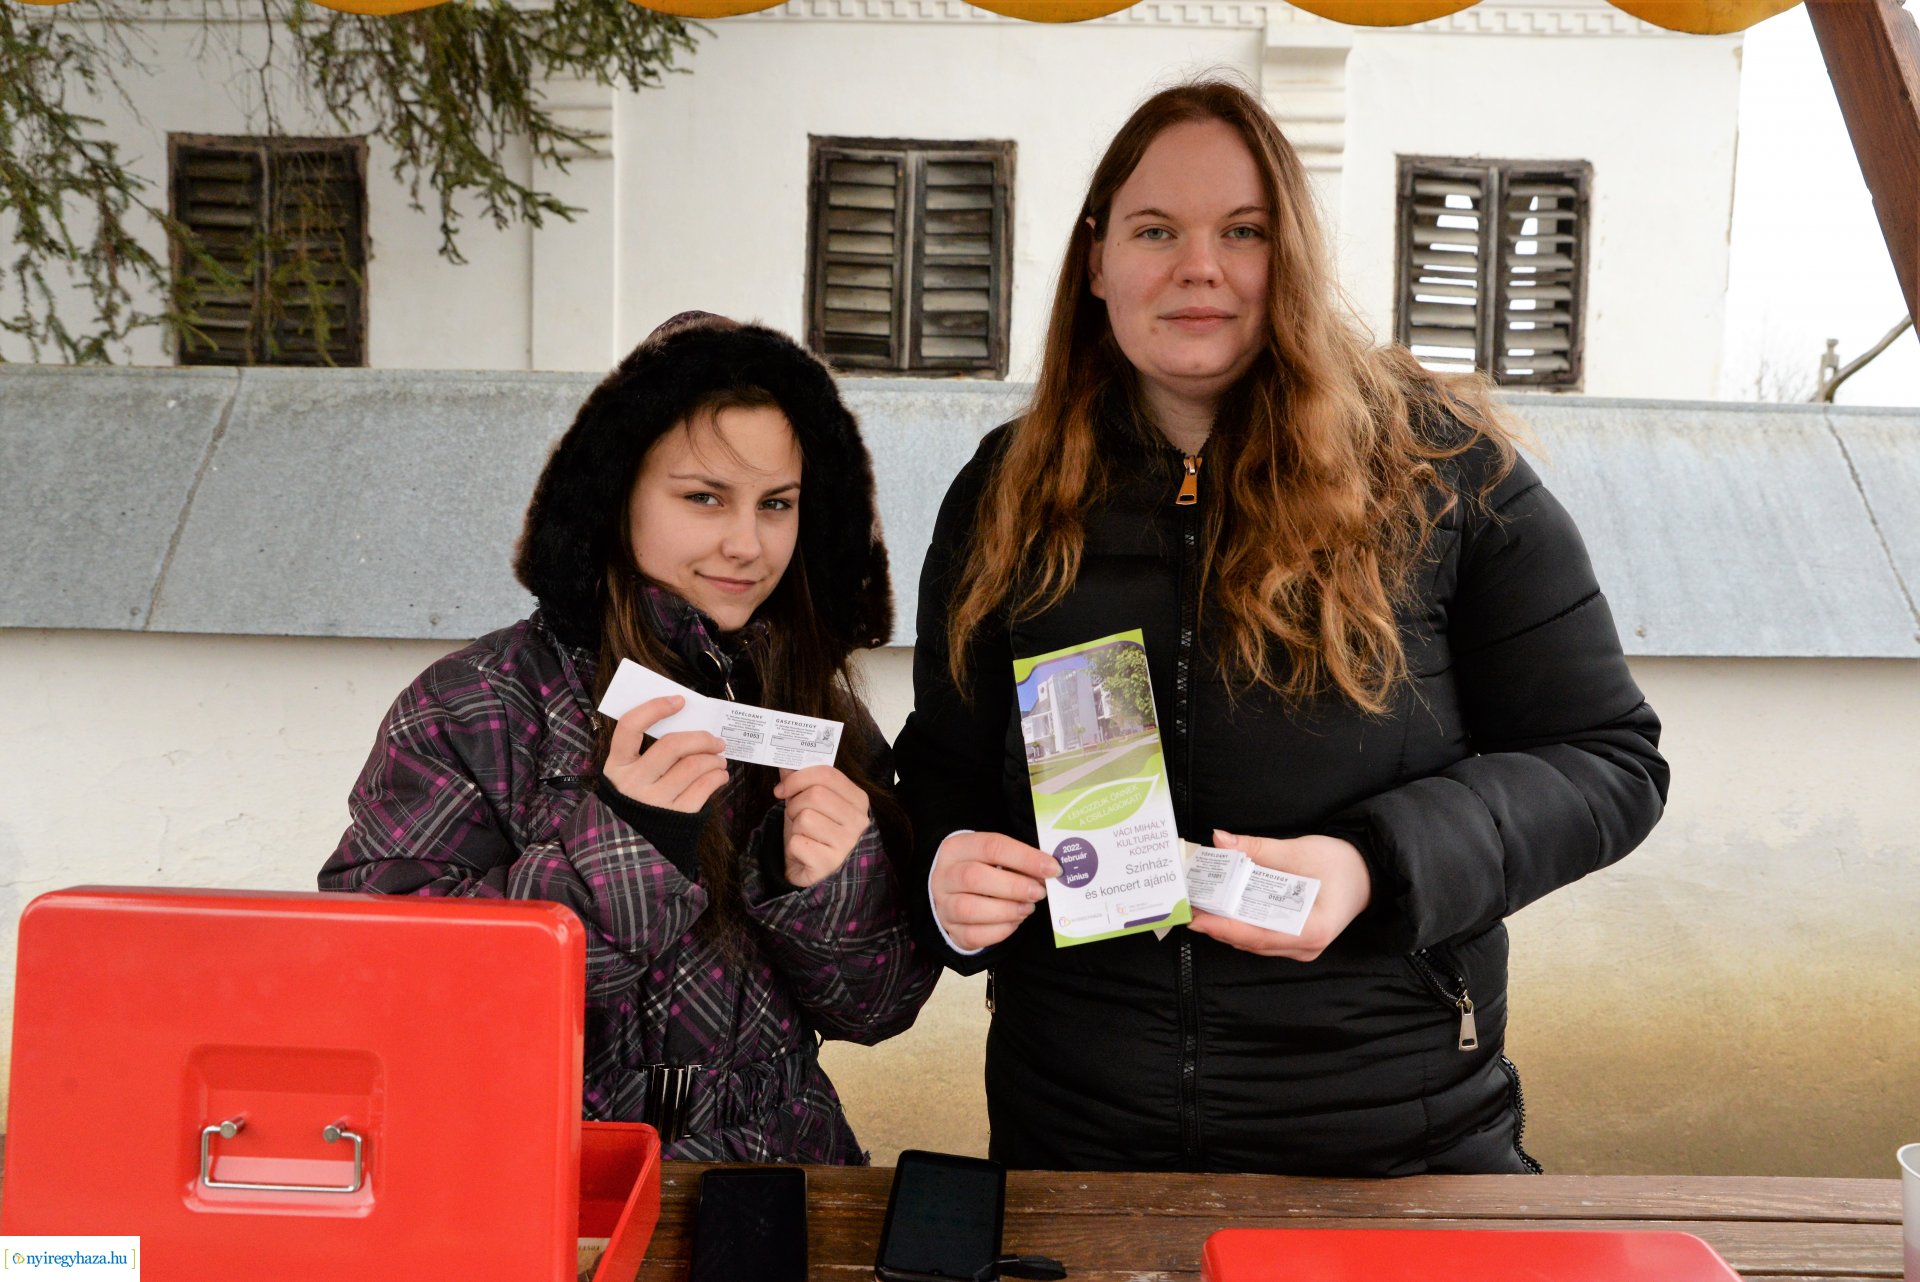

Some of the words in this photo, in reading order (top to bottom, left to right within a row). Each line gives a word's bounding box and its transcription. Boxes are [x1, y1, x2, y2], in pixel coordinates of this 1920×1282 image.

[775, 718, 817, 729] GASZTROJEGY
[743, 731, 760, 739] 01053
[1113, 824, 1133, 838] VÁCI
[1134, 818, 1167, 834] MIHÁLY
[1116, 830, 1169, 848] KULTURÁLIS
[1062, 843, 1082, 853] 2022.
[1129, 841, 1170, 856] KÖZPONT
[1060, 851, 1087, 864] február
[1125, 858, 1173, 875] Színház-
[1066, 872, 1089, 884] június
[1085, 889, 1098, 900] és
[1100, 881, 1141, 897] koncert
[1144, 870, 1177, 888] ajánló
